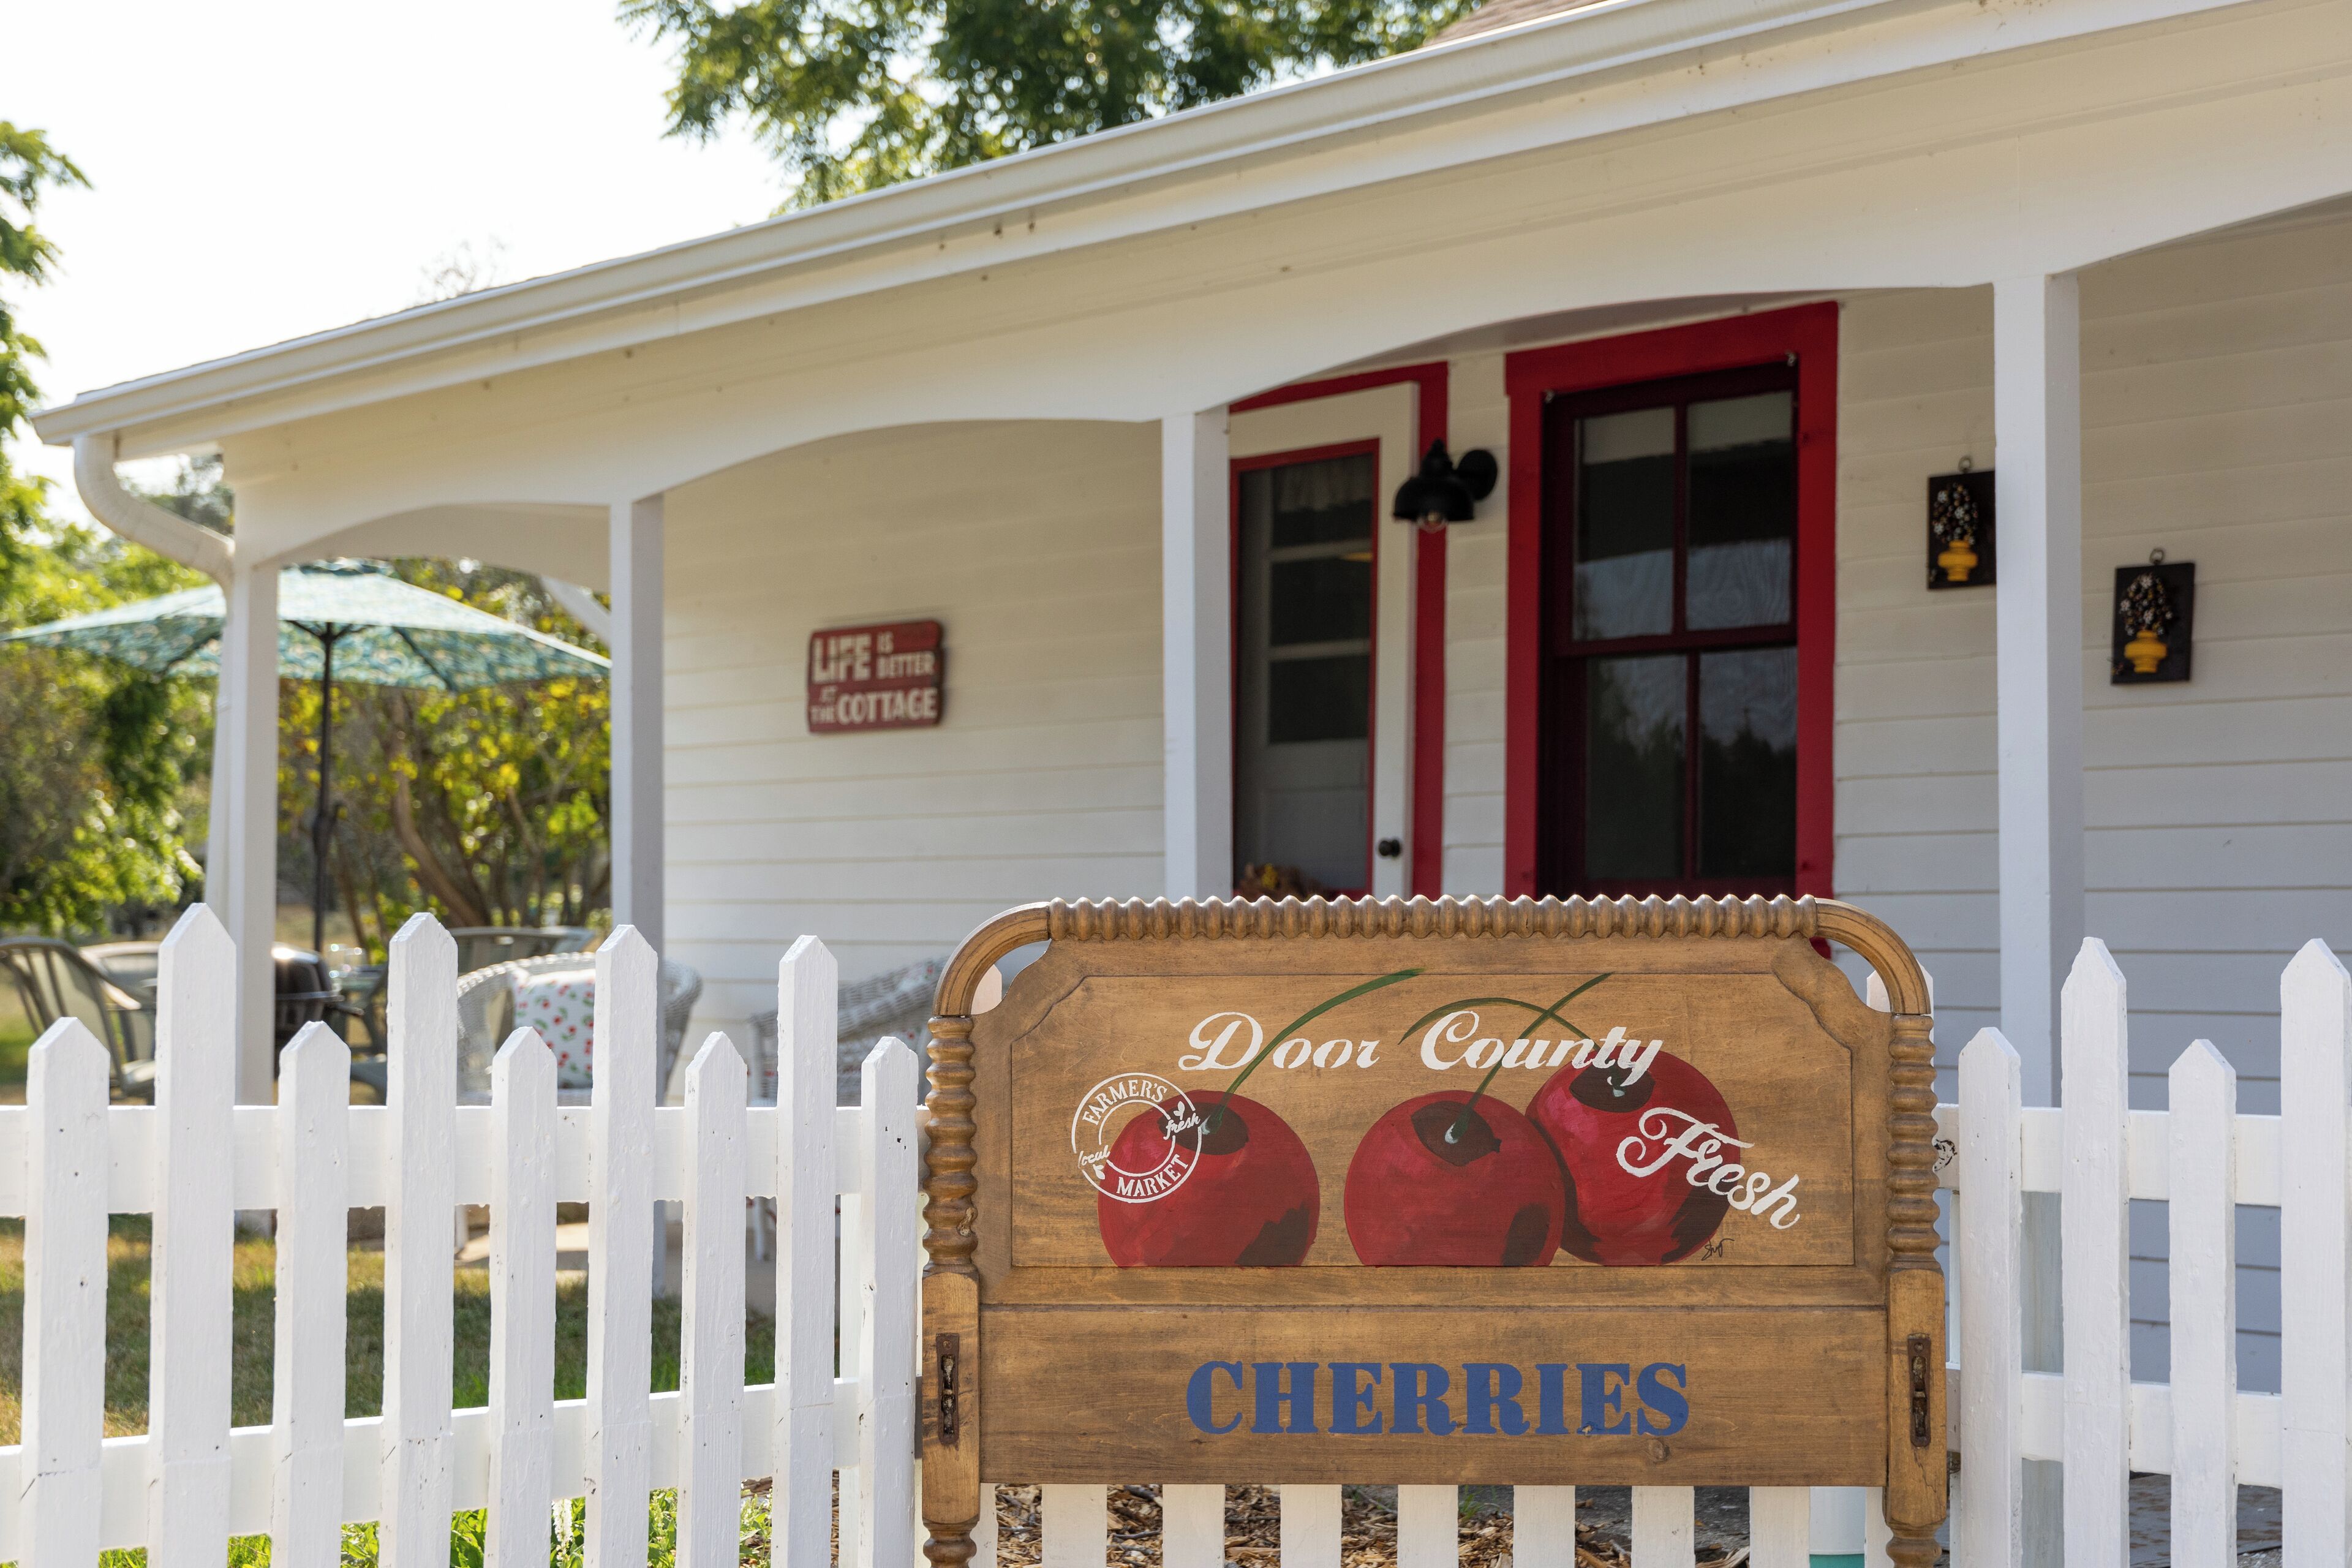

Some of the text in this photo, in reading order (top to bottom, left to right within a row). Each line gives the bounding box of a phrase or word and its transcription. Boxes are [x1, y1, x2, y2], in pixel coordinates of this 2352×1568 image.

[812, 631, 894, 685] LIFE IS
[875, 650, 936, 679] BETTER
[810, 687, 938, 725] THE COTTAGE
[1178, 1010, 1664, 1088] Door County
[1082, 1079, 1168, 1126] FARMER'S
[1163, 1112, 1201, 1140] fresh
[1115, 1153, 1189, 1197] MARKET
[1615, 1107, 1801, 1230] Fresh
[1186, 1360, 1691, 1436] CHERRIES
